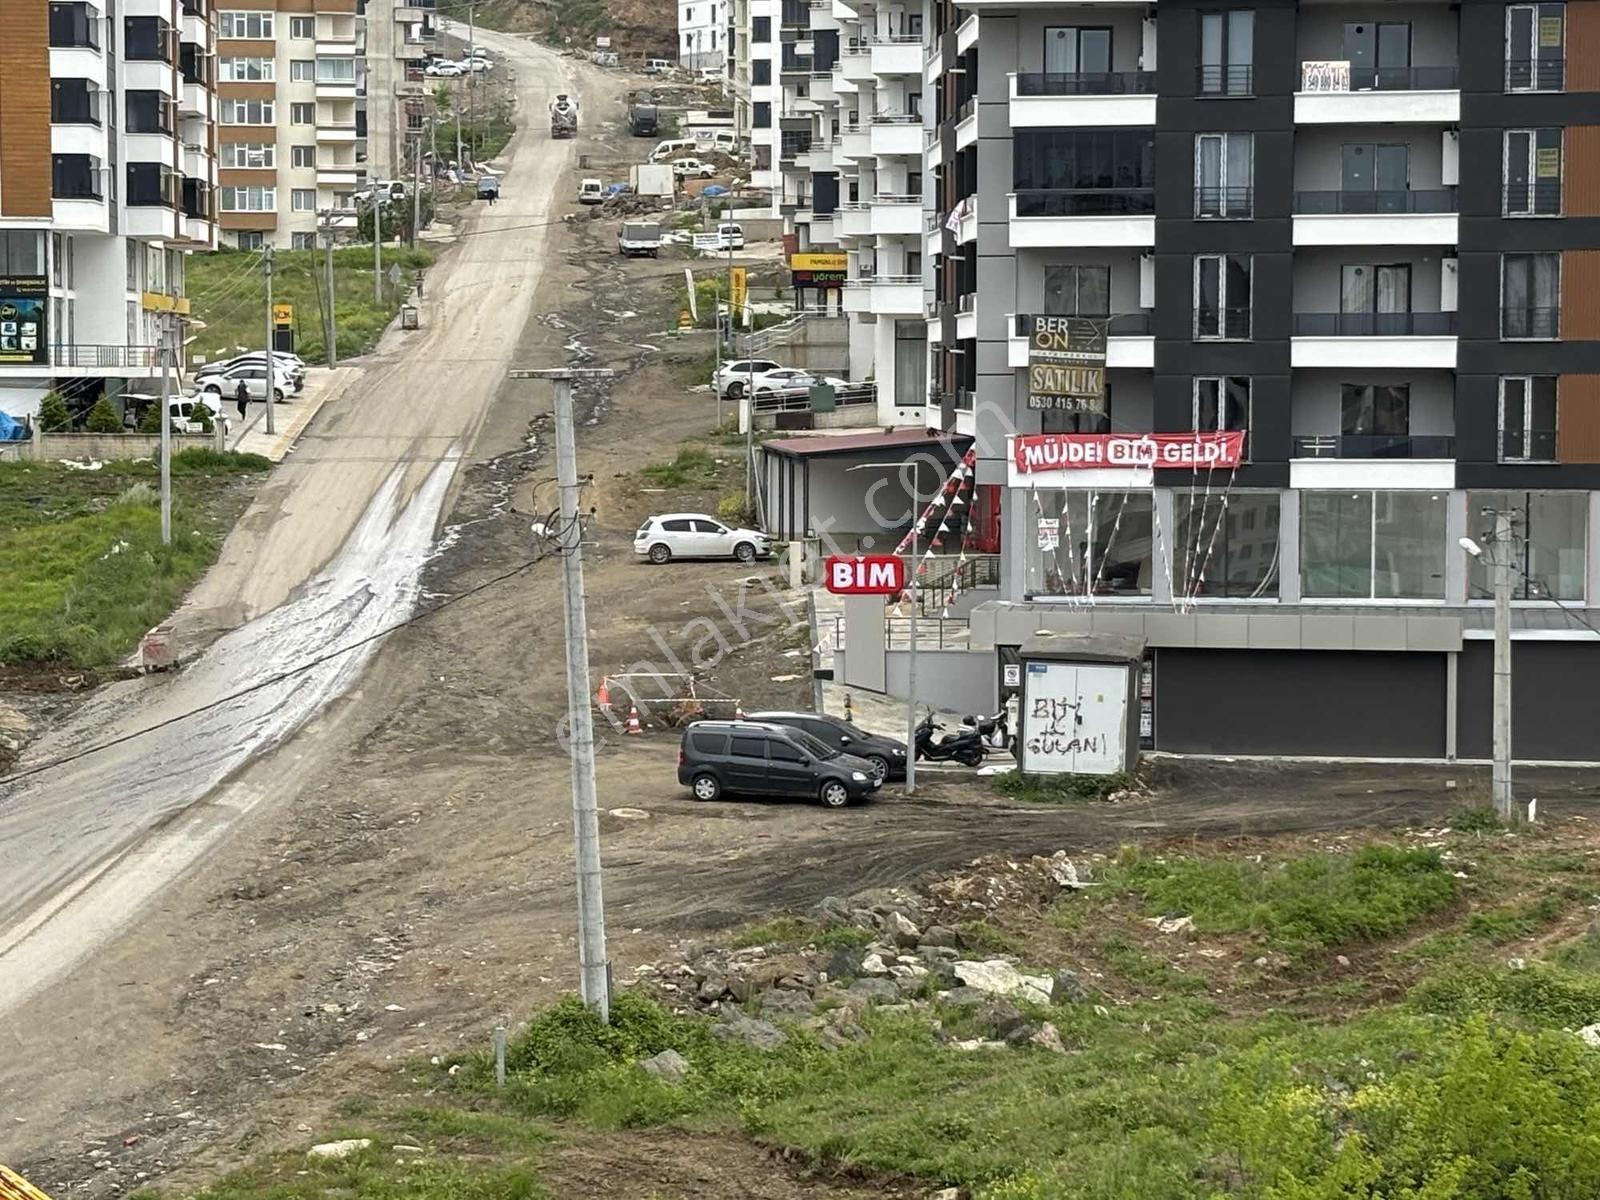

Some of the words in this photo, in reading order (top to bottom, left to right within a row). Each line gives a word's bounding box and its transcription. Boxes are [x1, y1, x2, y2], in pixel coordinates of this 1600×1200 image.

[1036, 317, 1068, 333] BER
[1036, 332, 1068, 349] ON
[1033, 367, 1098, 393] SATILIK
[1029, 395, 1052, 408] 0530
[1025, 439, 1101, 465] MÜJDE!
[1163, 437, 1233, 462] GELDİ.
[833, 557, 896, 588] BİM
